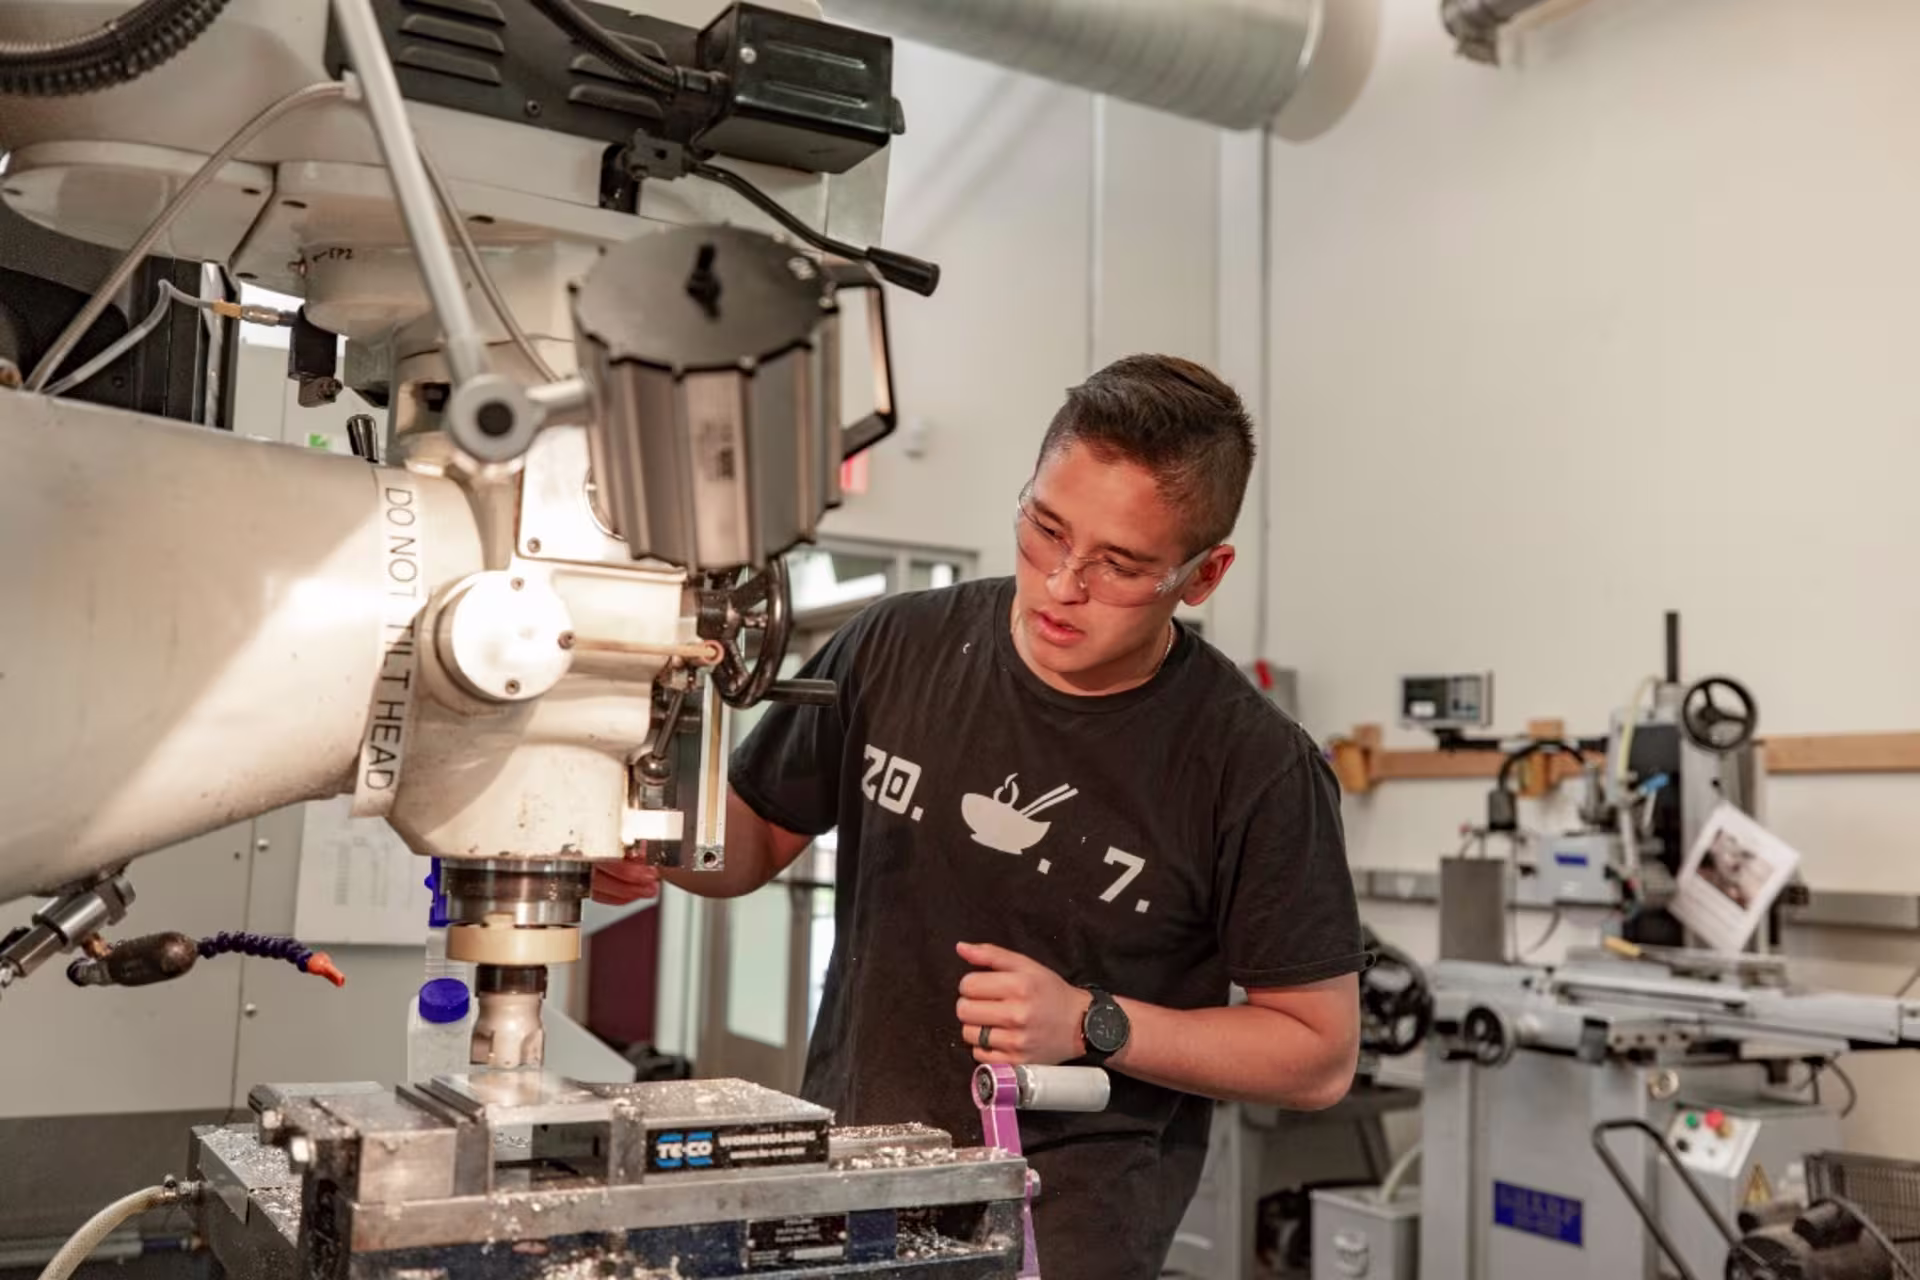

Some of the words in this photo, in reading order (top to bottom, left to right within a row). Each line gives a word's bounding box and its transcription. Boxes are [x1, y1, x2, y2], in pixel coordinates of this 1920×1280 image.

[386, 487, 415, 526] DO
[389, 536, 417, 598] NOT
[381, 618, 415, 690] TILT
[366, 700, 405, 790] HEAD
[719, 1130, 817, 1147] WORKHOLDING
